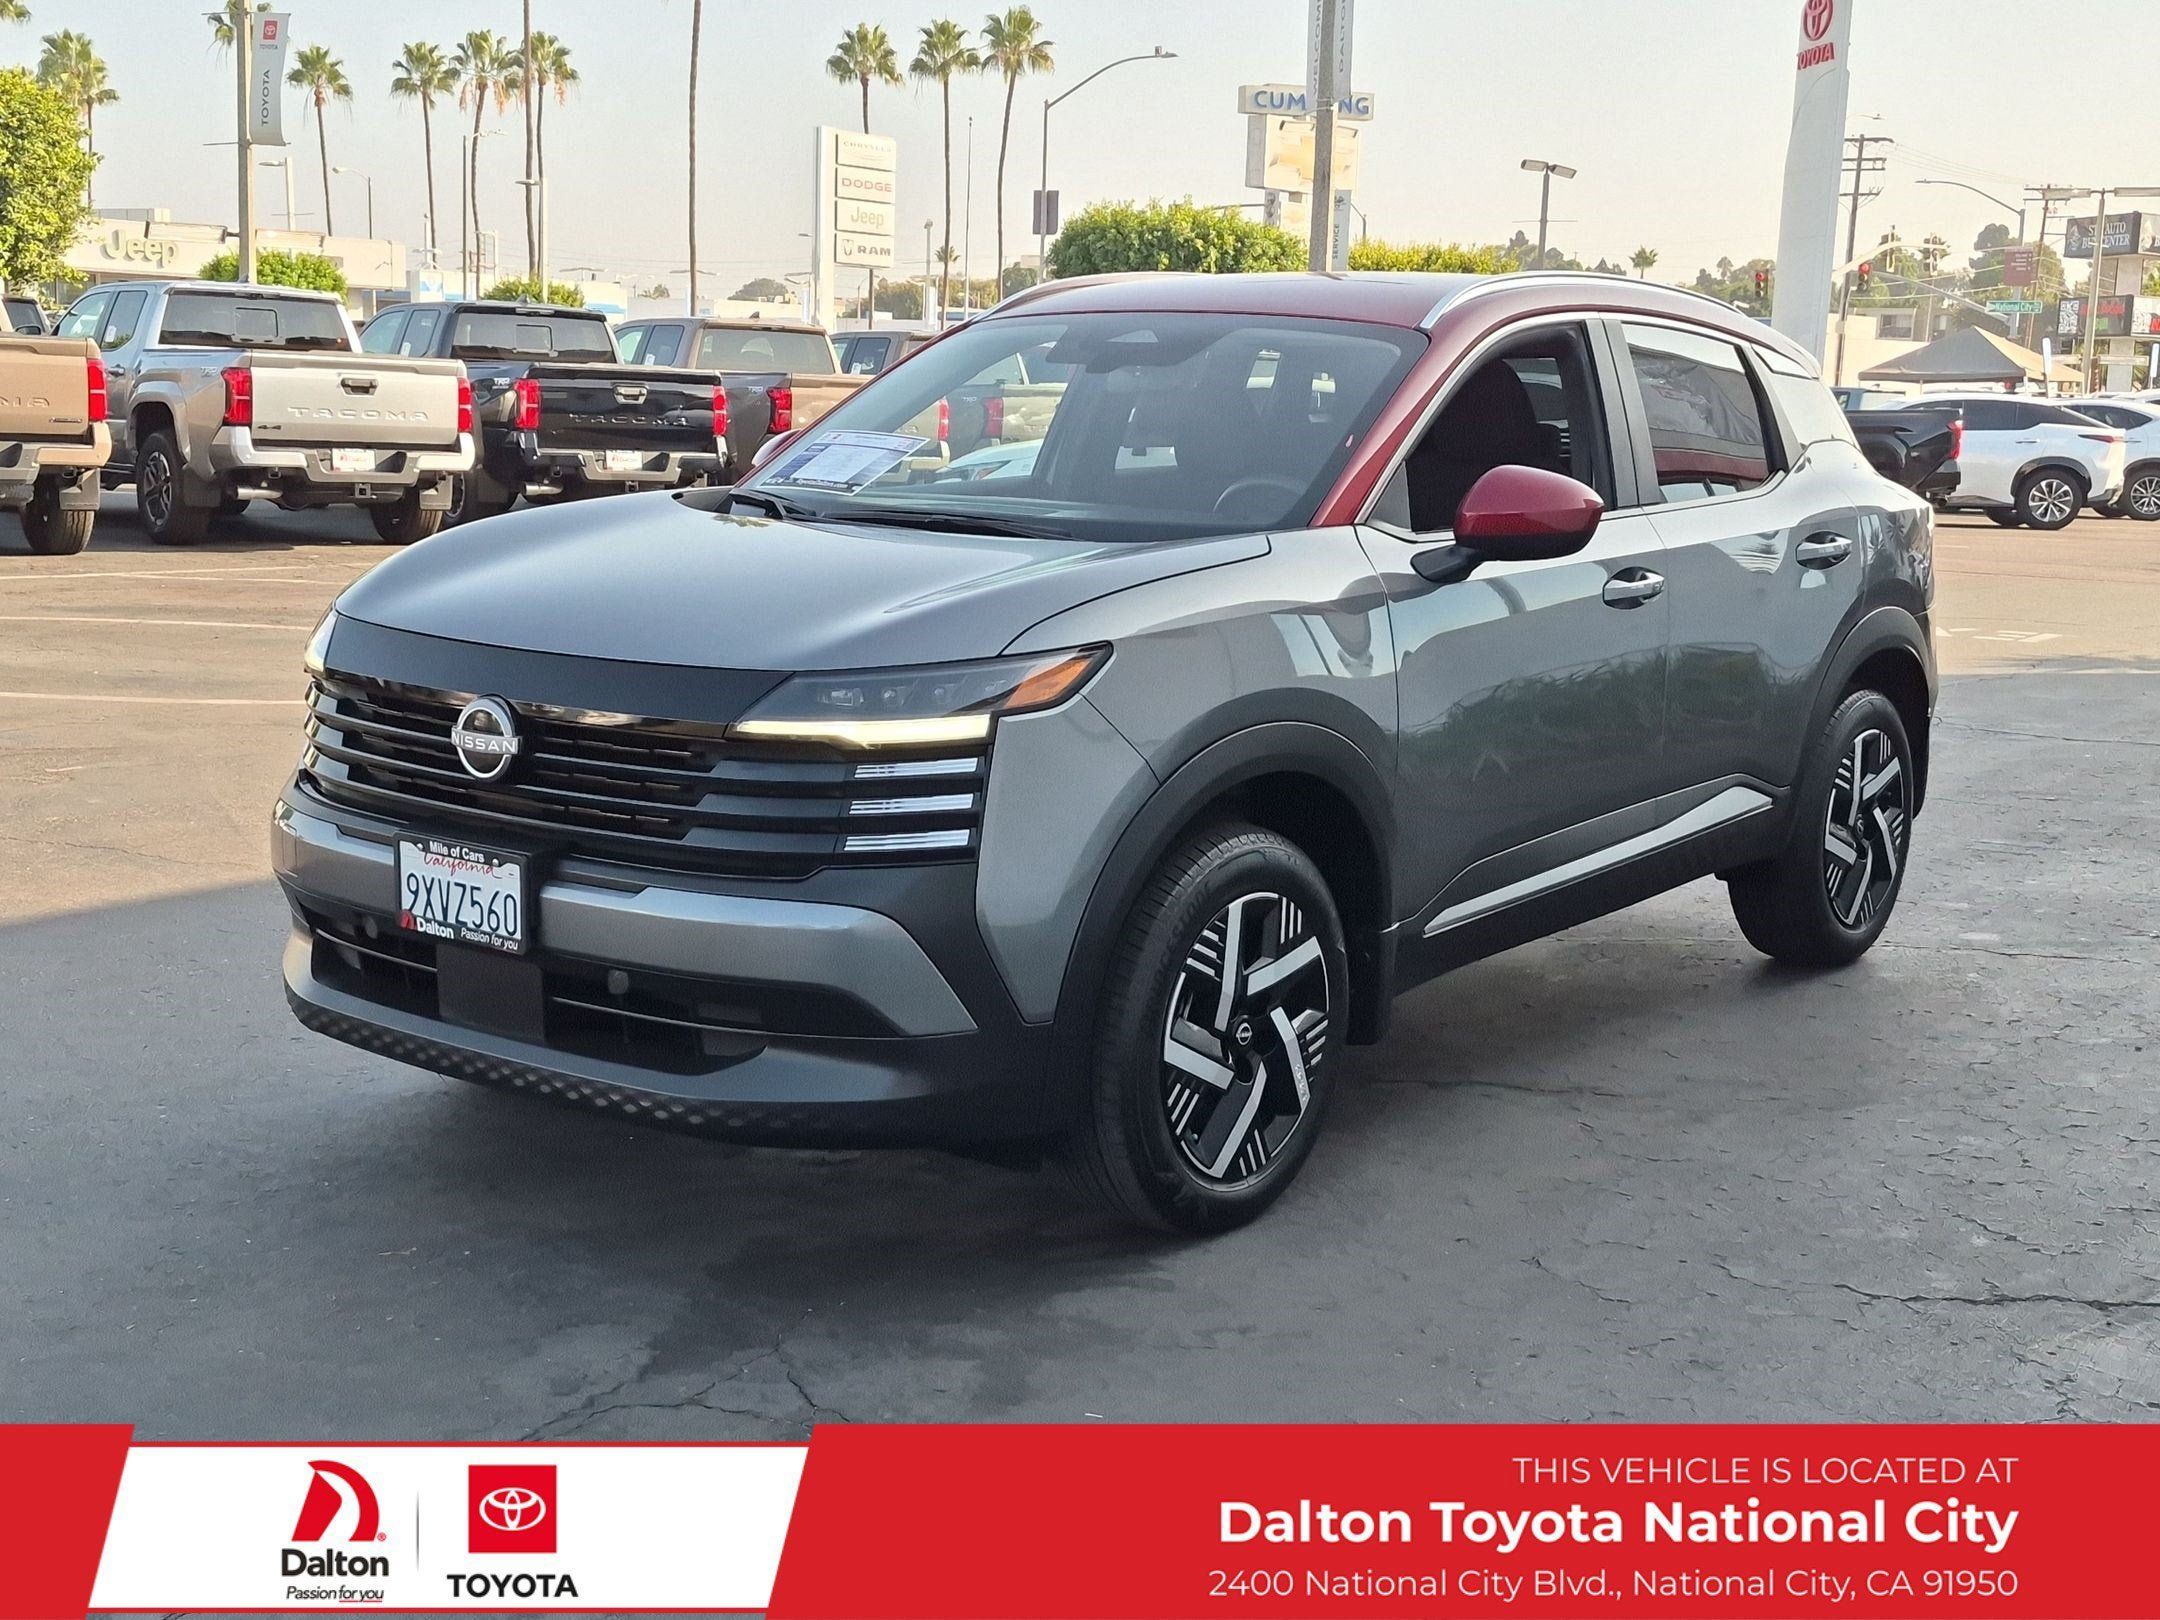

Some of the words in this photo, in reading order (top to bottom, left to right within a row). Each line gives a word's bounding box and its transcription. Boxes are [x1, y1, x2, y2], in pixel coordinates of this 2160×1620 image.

[1338, 0, 1347, 73] DALTO
[1312, 0, 1322, 97] WELCOM
[1796, 42, 1835, 70] TOYOTA
[261, 69, 271, 126] TOYOTA
[1254, 90, 1369, 114] CUMNG
[841, 177, 893, 192] DODGE
[850, 206, 885, 229] Jeep
[2104, 221, 2127, 235] AUTO
[101, 229, 178, 269] Jeep
[857, 245, 892, 257] RAM
[1332, 223, 1340, 259] SERVICE
[494, 377, 511, 386] TRD
[287, 406, 429, 422] TACOMA
[569, 413, 690, 427] TACOMA
[451, 731, 516, 753] NISSAN
[429, 840, 449, 855] Mile
[450, 846, 461, 857] of
[462, 848, 485, 863] Cars
[406, 872, 518, 937] 9XVZ560
[416, 916, 455, 939] Dalton
[460, 927, 490, 945] Passion
[490, 933, 504, 947] for
[503, 939, 519, 952] you
